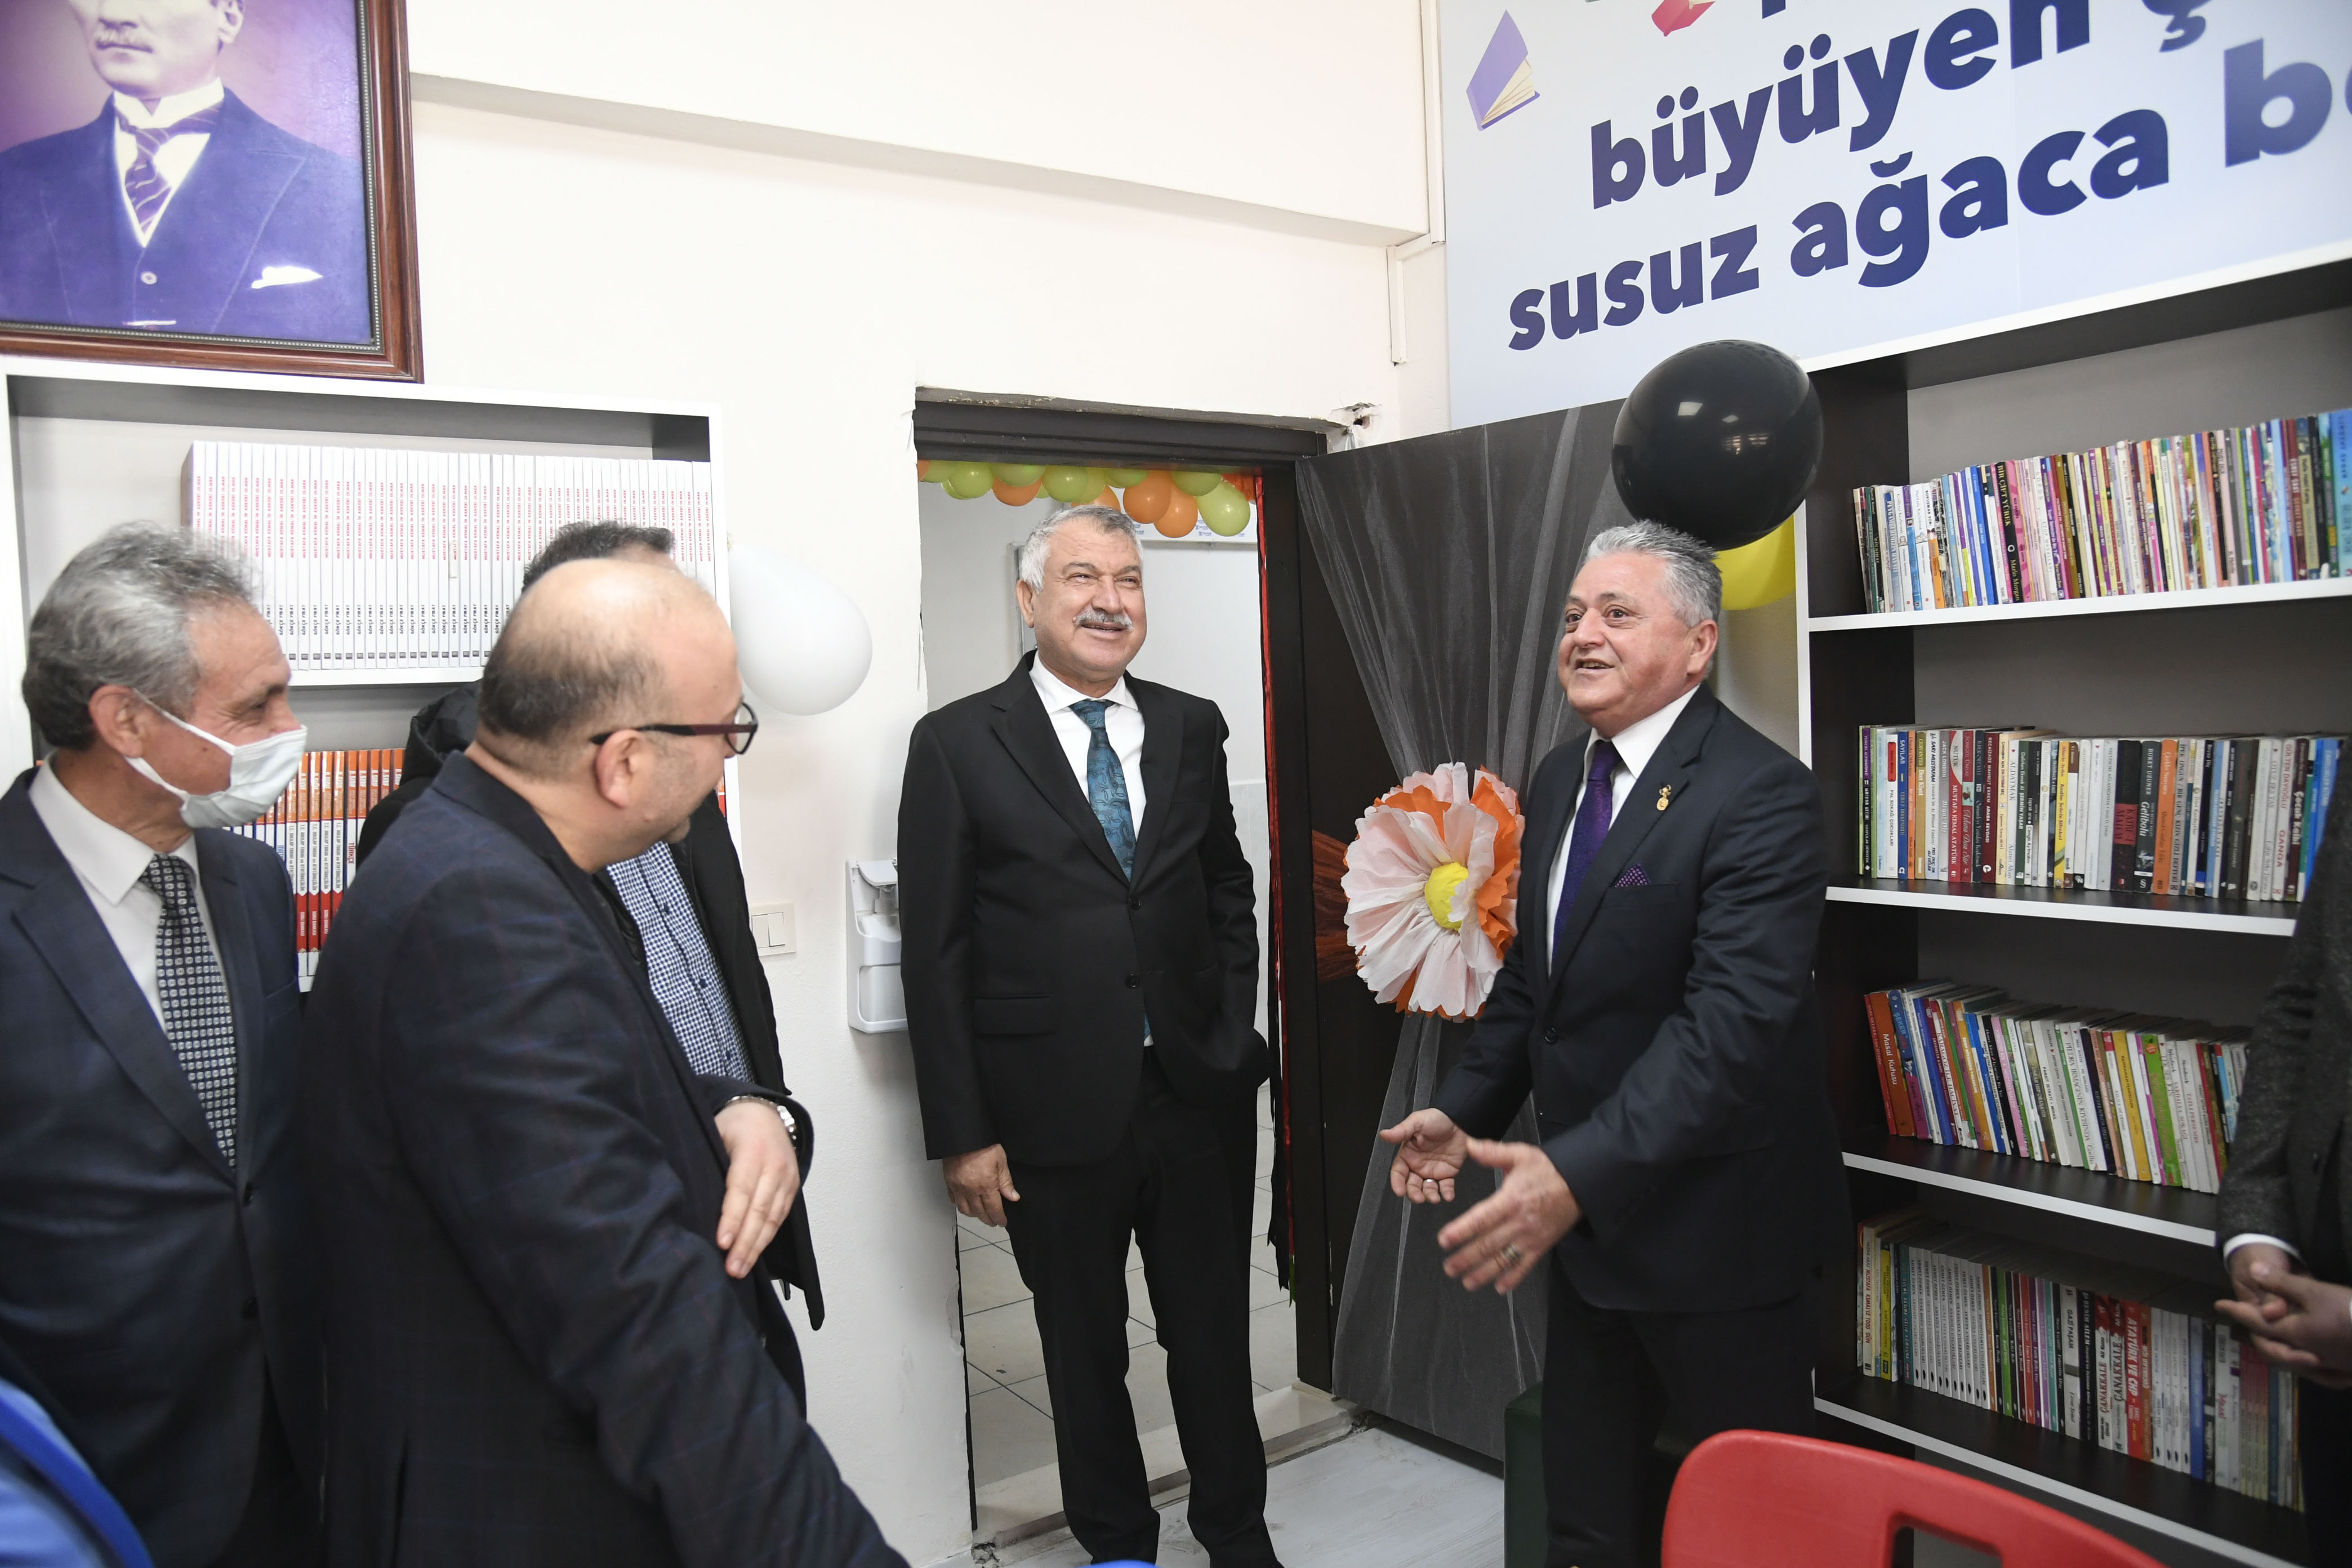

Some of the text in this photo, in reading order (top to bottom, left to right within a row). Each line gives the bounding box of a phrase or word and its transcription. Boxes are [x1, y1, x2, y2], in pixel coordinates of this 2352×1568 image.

[1591, 0, 2089, 209] büyüyen
[1508, 37, 2352, 351] susuz ağaca b
[2002, 499, 2011, 526] YÜREK
[2280, 774, 2291, 809] DAYIOĞLU
[2139, 802, 2150, 836] Gelibolu
[2292, 791, 2304, 845] Çocuk Kalbi
[1962, 835, 1971, 849] Dua
[1962, 852, 1971, 865] Sür
[2276, 830, 2286, 867] GANGA
[1894, 1013, 1906, 1035] ŞEKER
[1883, 1034, 1897, 1085] Masal Kutusu
[2113, 1342, 2126, 1402] ÇANAKKALE
[2127, 1318, 2140, 1396] ATATÜRK VE CHP
[2099, 1362, 2110, 1413] ÇANAKKALE
